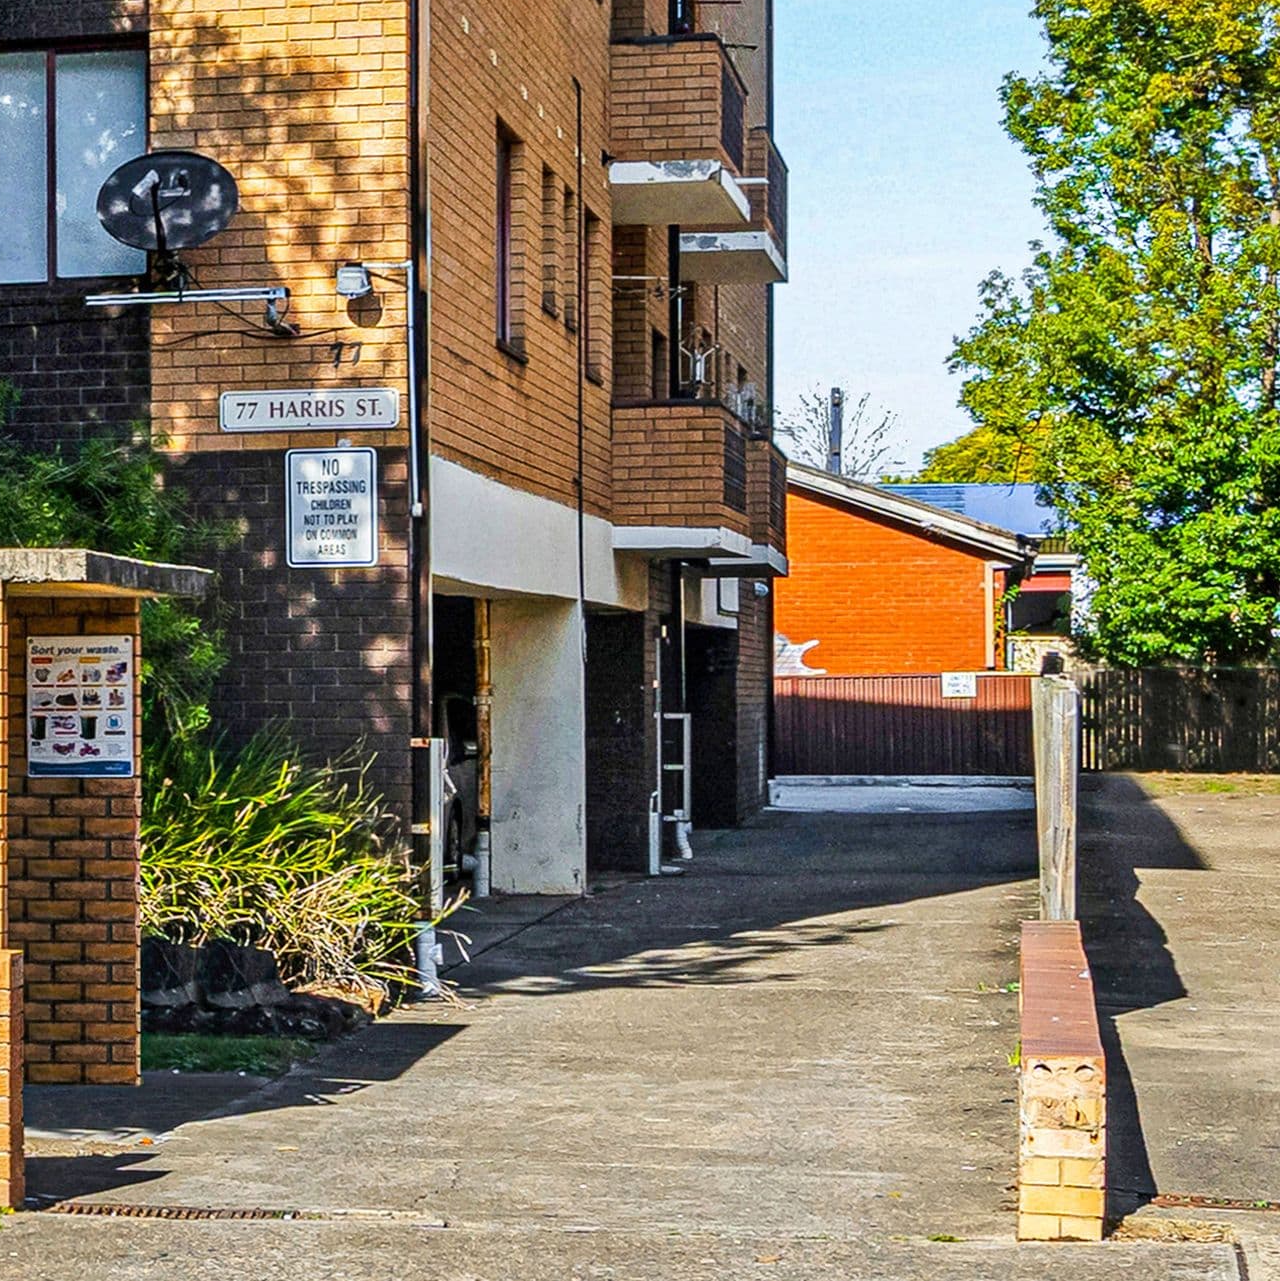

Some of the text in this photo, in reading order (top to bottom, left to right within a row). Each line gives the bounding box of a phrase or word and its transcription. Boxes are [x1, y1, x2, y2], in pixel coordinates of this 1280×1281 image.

[329, 341, 362, 368] 77
[236, 398, 383, 419] 77 HARRIS ST.
[322, 458, 340, 476] NO
[296, 480, 366, 495] TRESPASSING
[311, 499, 352, 511] CHILDREN
[304, 514, 359, 526] NOT TO PLAY
[306, 528, 358, 541] ON COMMON
[318, 543, 346, 555] AREAS
[31, 645, 54, 655] Sort
[57, 646, 83, 656] your
